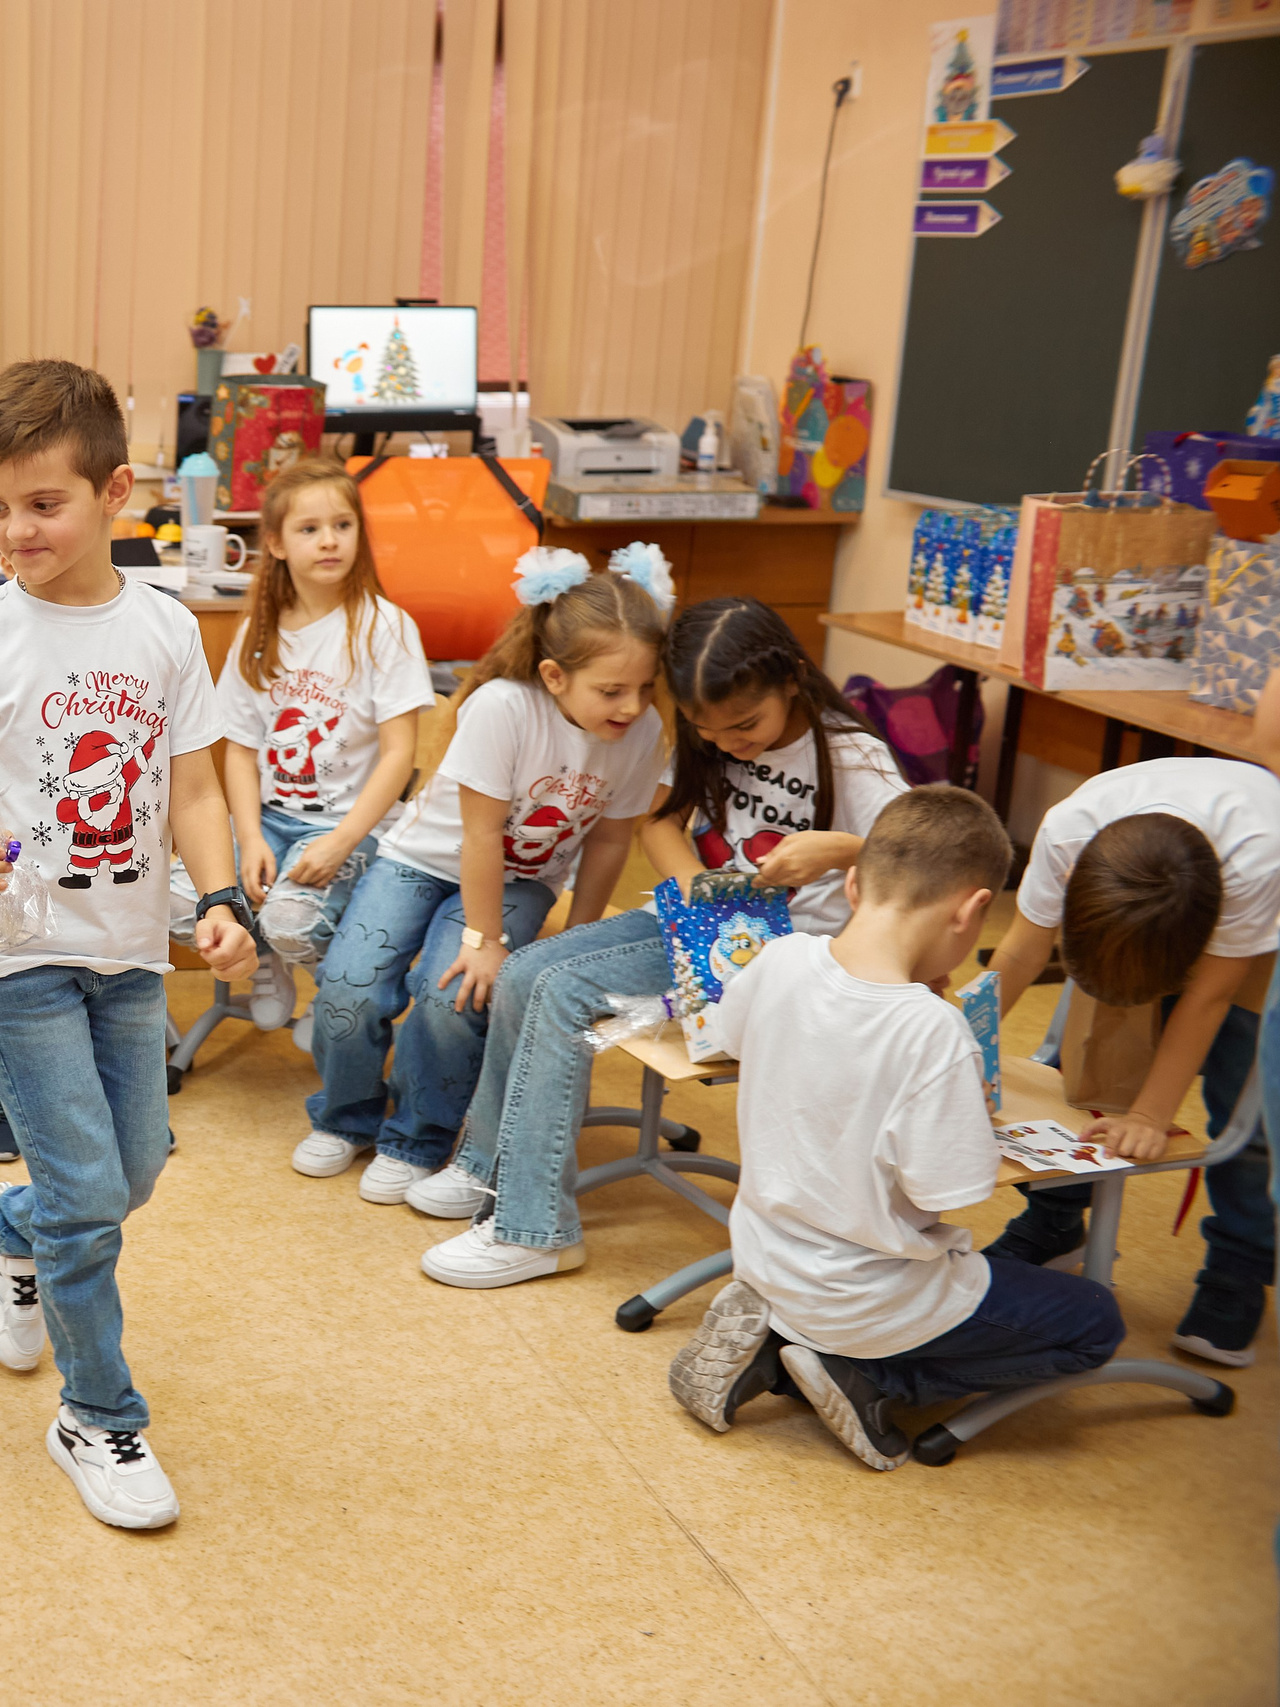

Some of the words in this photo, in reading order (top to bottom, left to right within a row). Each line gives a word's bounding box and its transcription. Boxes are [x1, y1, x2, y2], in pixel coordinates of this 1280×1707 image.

[85, 670, 150, 699] Merry
[292, 669, 335, 689] Merry
[40, 689, 169, 739] Christmas
[269, 681, 348, 718] Christmas
